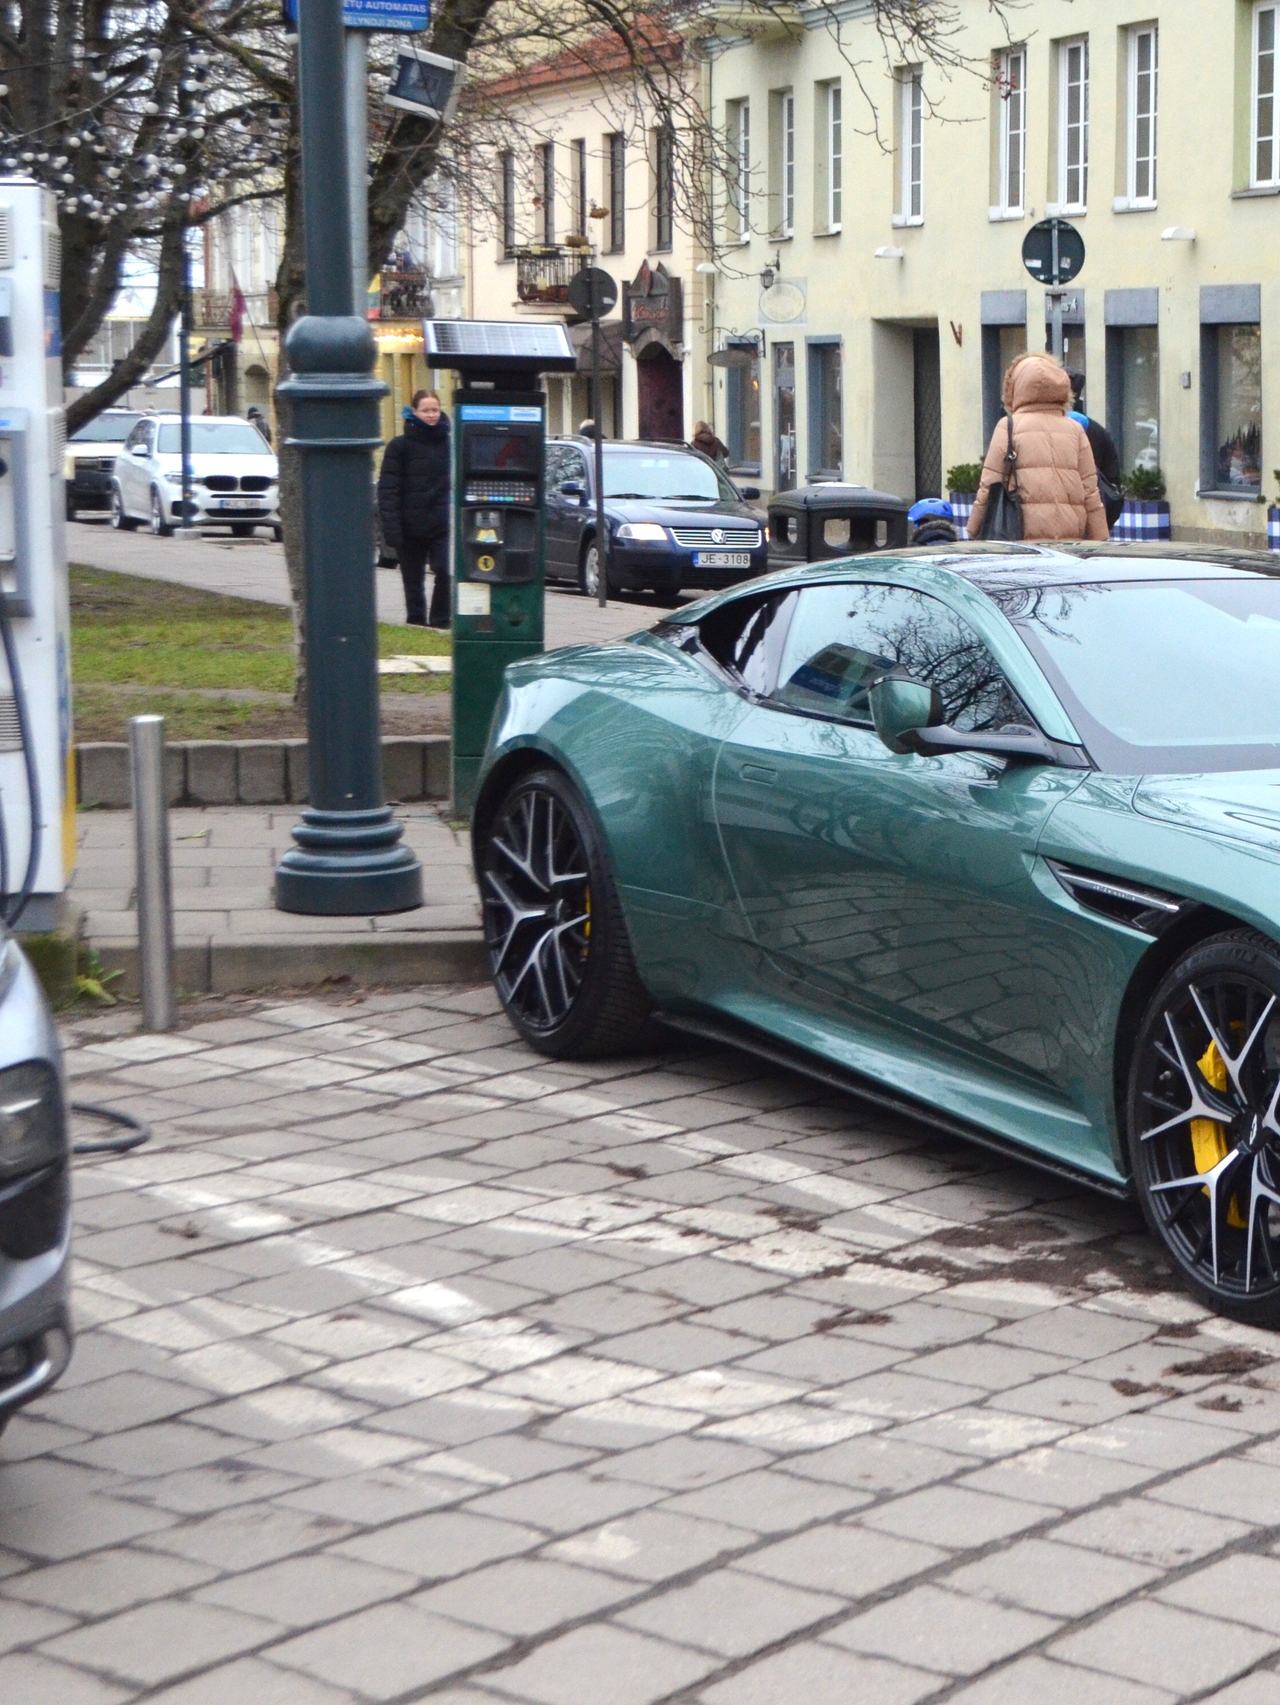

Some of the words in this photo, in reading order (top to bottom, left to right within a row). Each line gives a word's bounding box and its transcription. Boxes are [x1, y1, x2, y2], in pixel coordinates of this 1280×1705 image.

[366, 1, 427, 13] AUTOMATAS
[387, 19, 415, 31] ZONA
[701, 553, 749, 565] JE-3108
